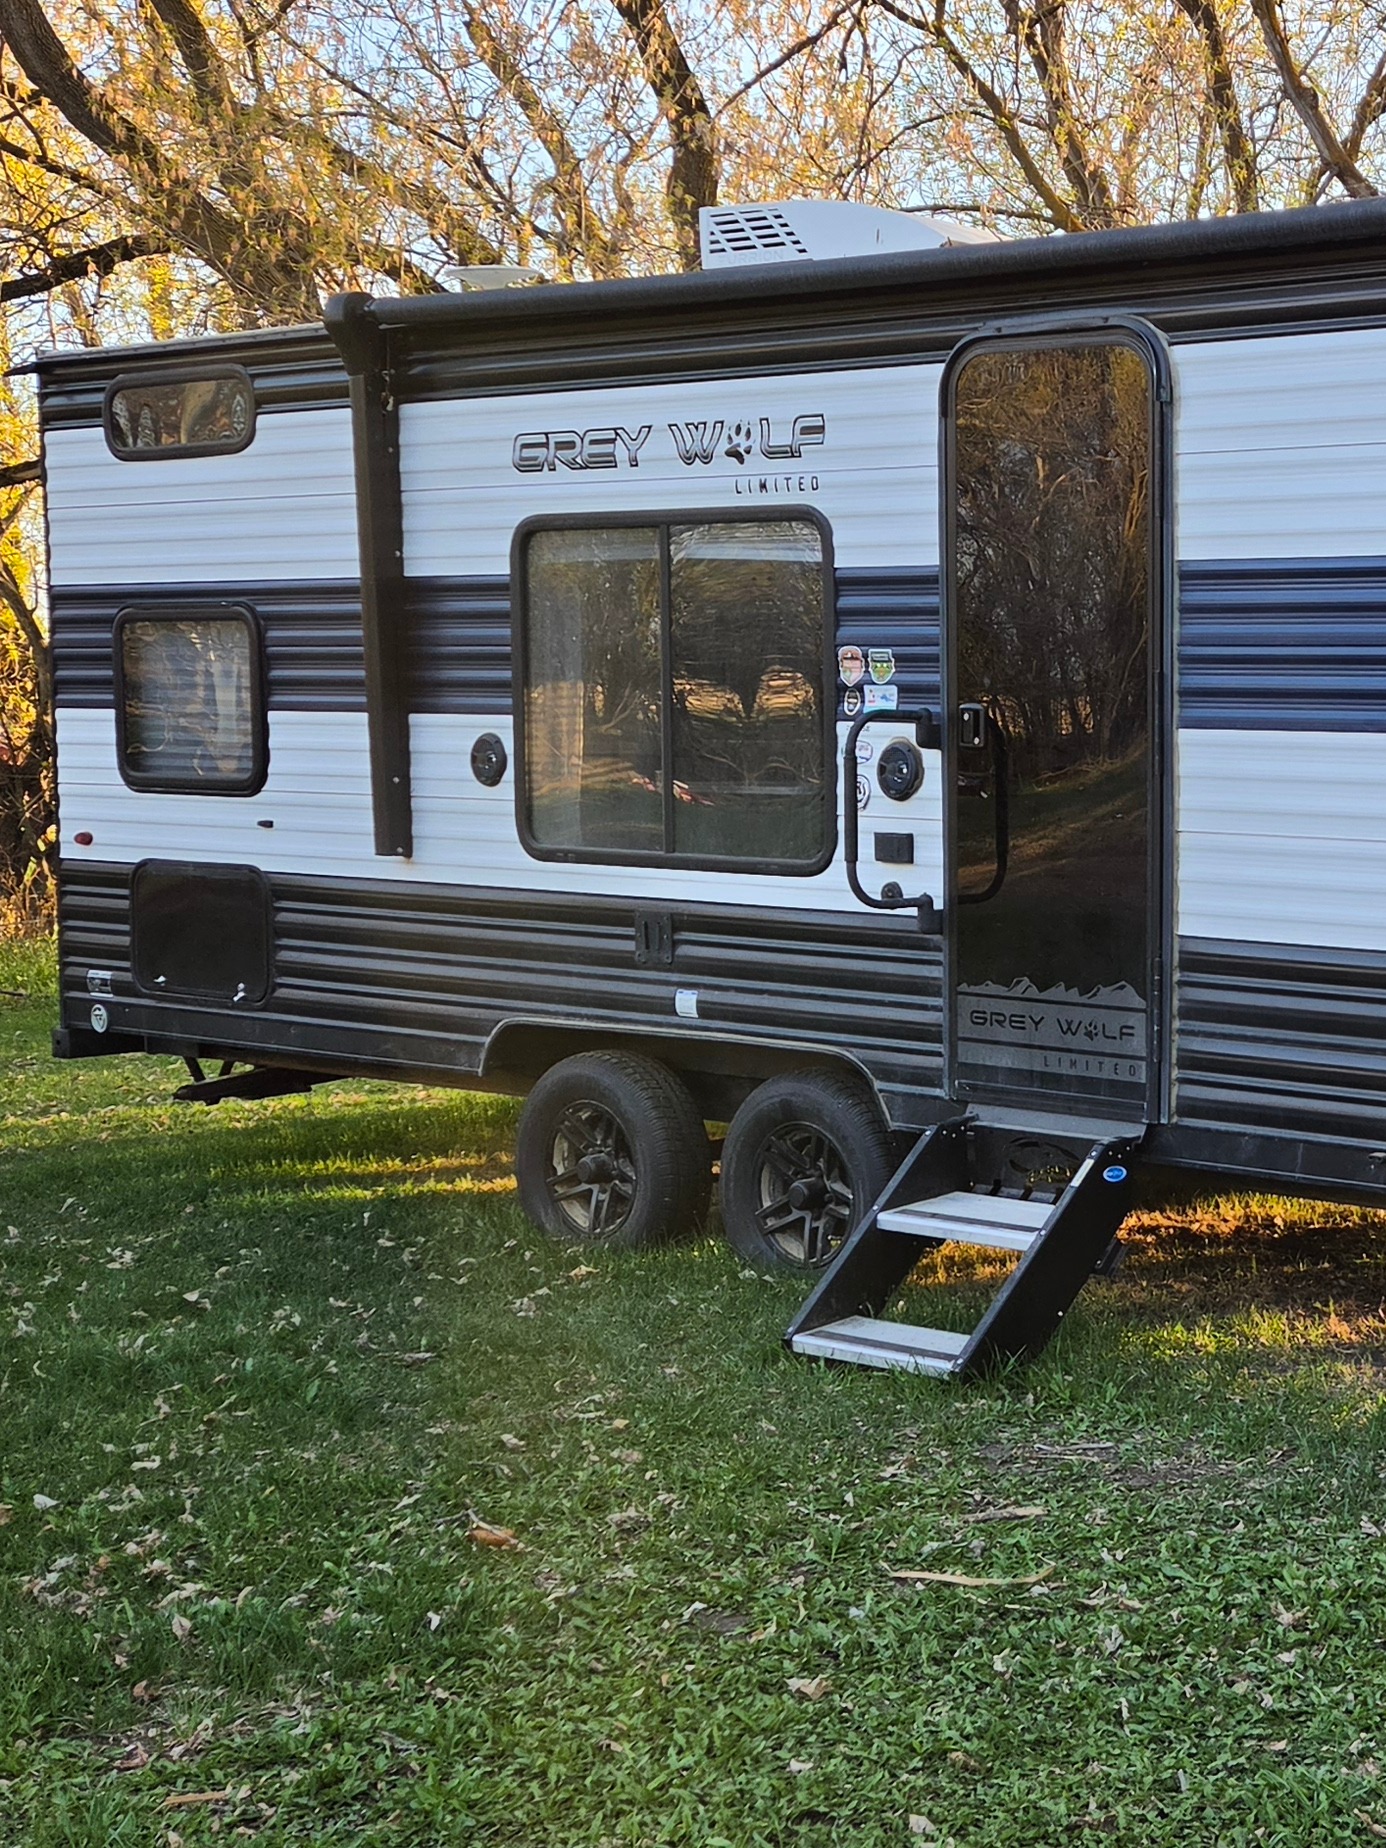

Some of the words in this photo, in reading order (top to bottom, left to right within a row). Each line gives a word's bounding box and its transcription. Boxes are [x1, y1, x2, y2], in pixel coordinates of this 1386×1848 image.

[512, 424, 653, 473] GREY
[735, 475, 820, 495] LIMITED
[970, 1009, 1045, 1032] GREY
[1043, 1054, 1137, 1077] LIMITED
